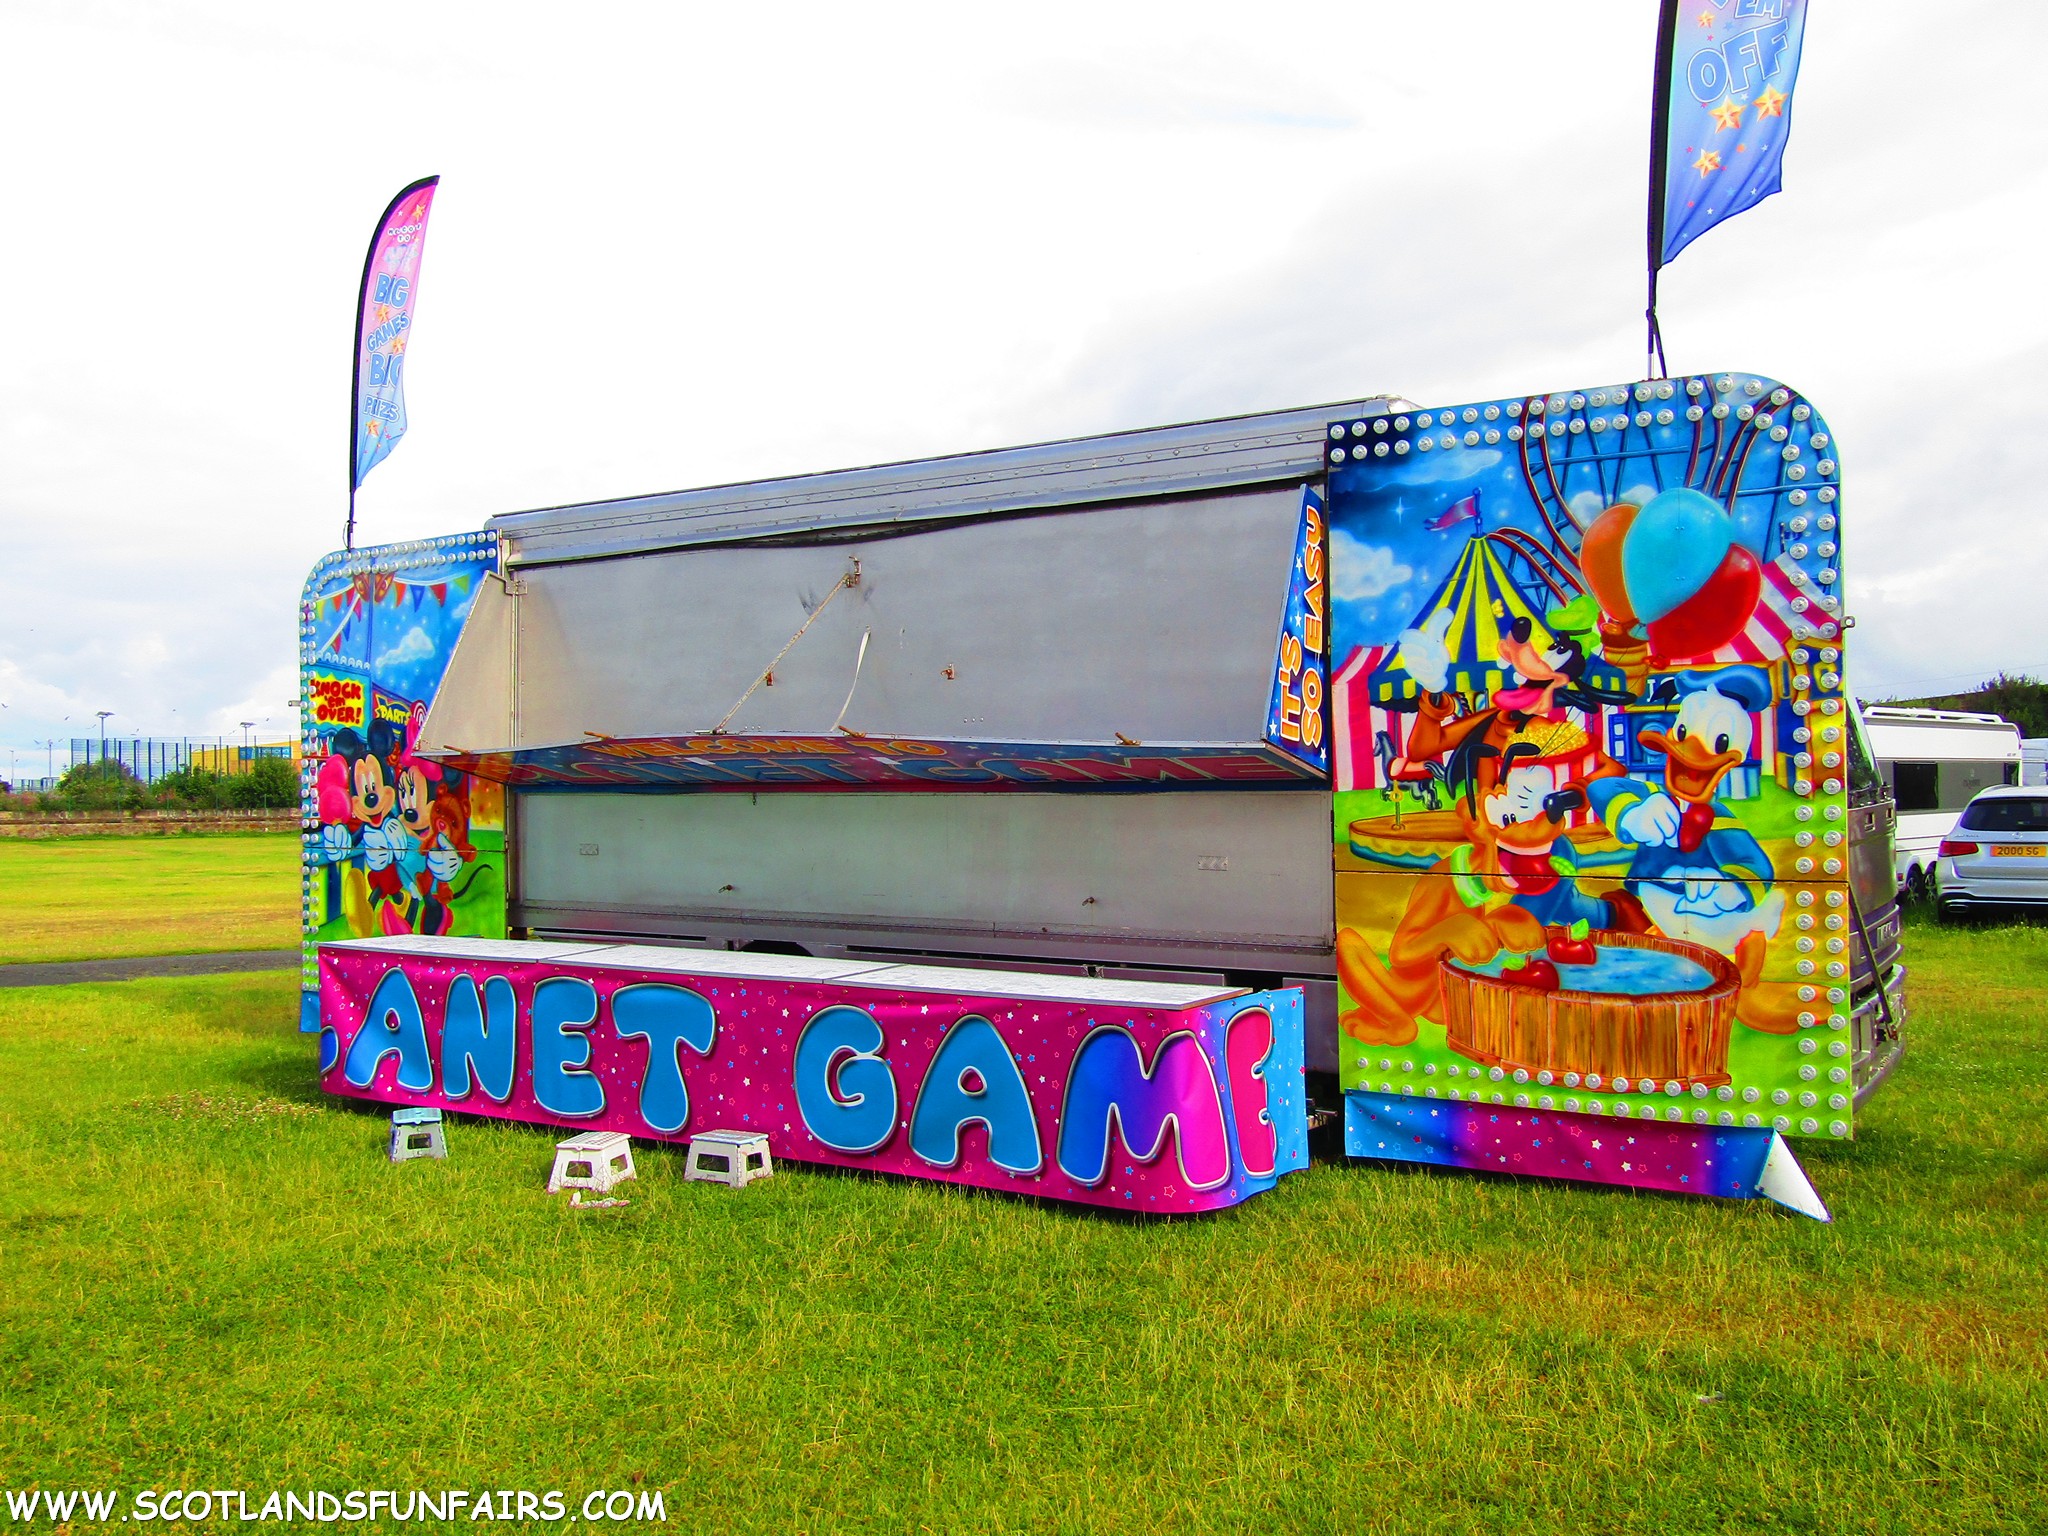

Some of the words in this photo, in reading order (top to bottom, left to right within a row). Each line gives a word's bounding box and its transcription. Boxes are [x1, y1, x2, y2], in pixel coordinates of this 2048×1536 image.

[1687, 18, 1789, 104] OFF
[397, 235, 411, 243] TO
[373, 272, 410, 309] BIG
[366, 311, 411, 353] GAMES
[1303, 505, 1325, 655] EASY
[310, 679, 362, 700] KNOCK
[1279, 631, 1303, 743] IT'S
[316, 704, 362, 725] OVER!
[1301, 667, 1323, 749] SO
[583, 738, 854, 759] WELCOME
[848, 740, 948, 757] TO
[892, 756, 1308, 784] GAME
[1997, 846, 2023, 856] 2000
[319, 966, 717, 1133] ANET
[793, 1004, 1279, 1190] GAME
